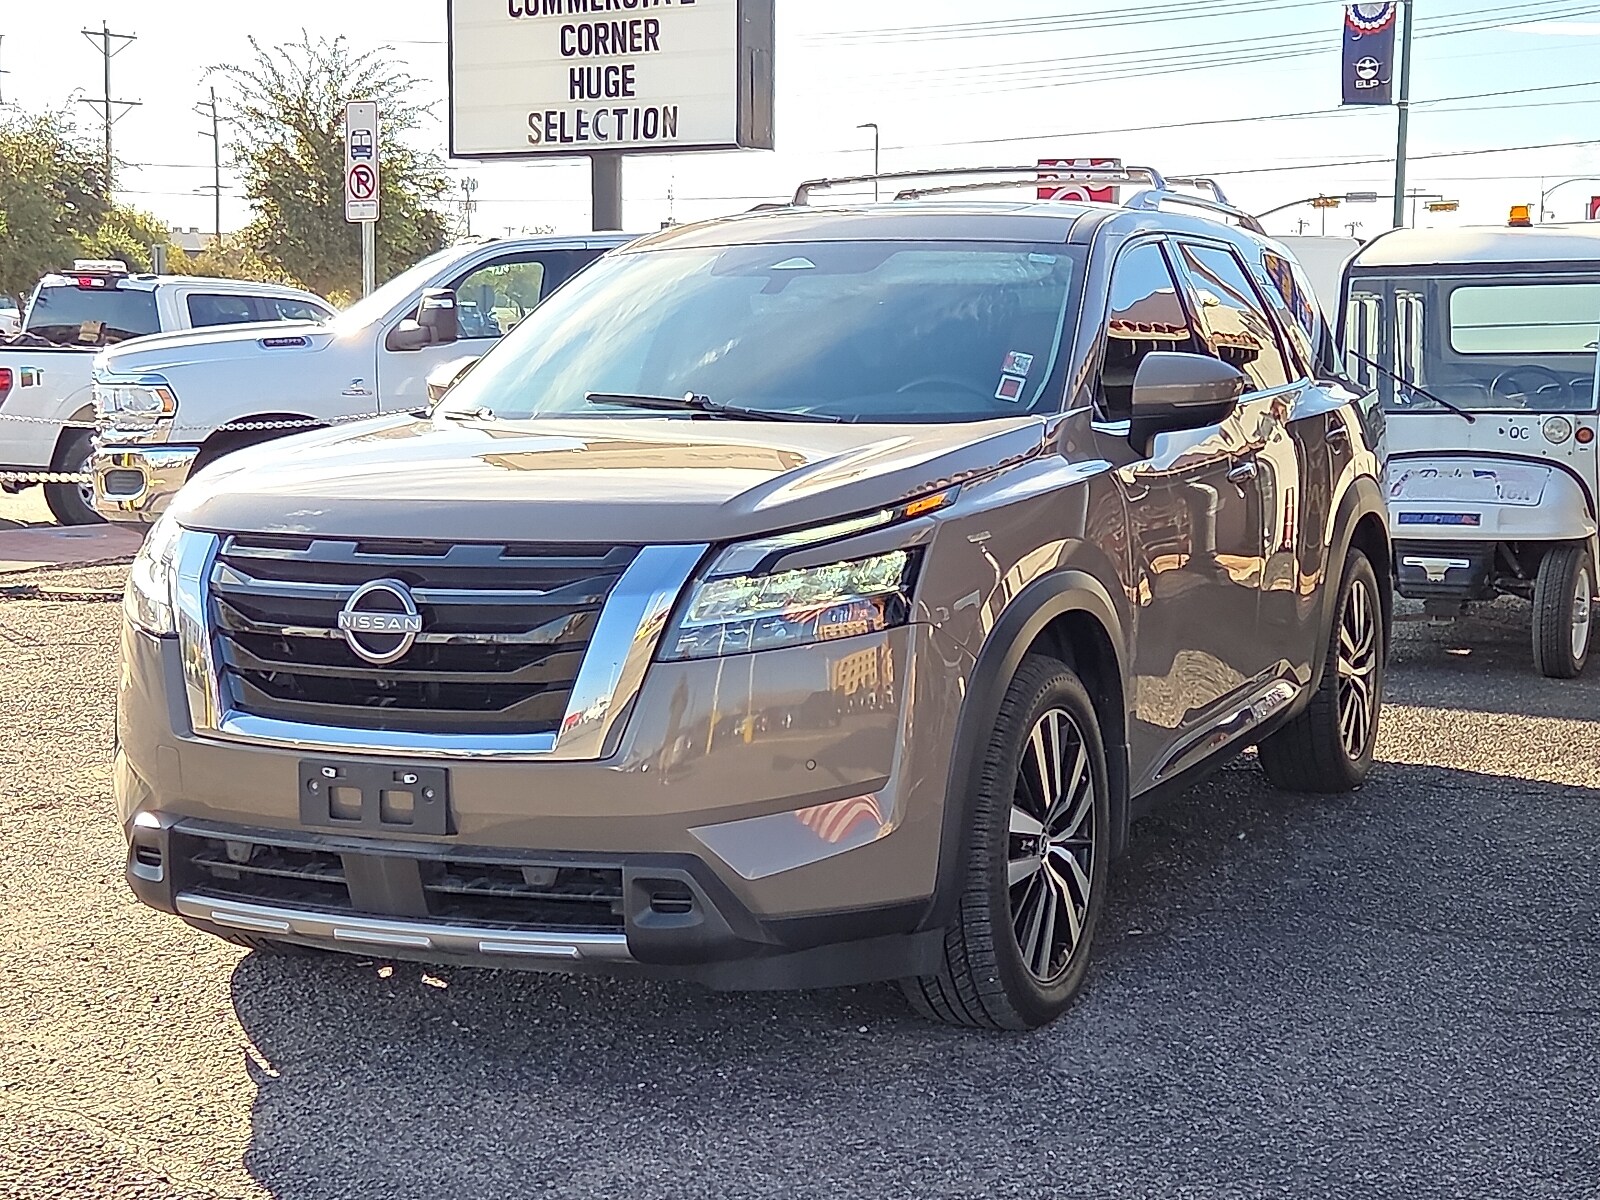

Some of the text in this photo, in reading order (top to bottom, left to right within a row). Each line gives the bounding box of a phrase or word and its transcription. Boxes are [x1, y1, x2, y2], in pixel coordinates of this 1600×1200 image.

[561, 19, 660, 57] CORNER
[570, 64, 636, 101] HUGE
[528, 105, 679, 145] SELECTION
[340, 616, 419, 629] NISSAN
